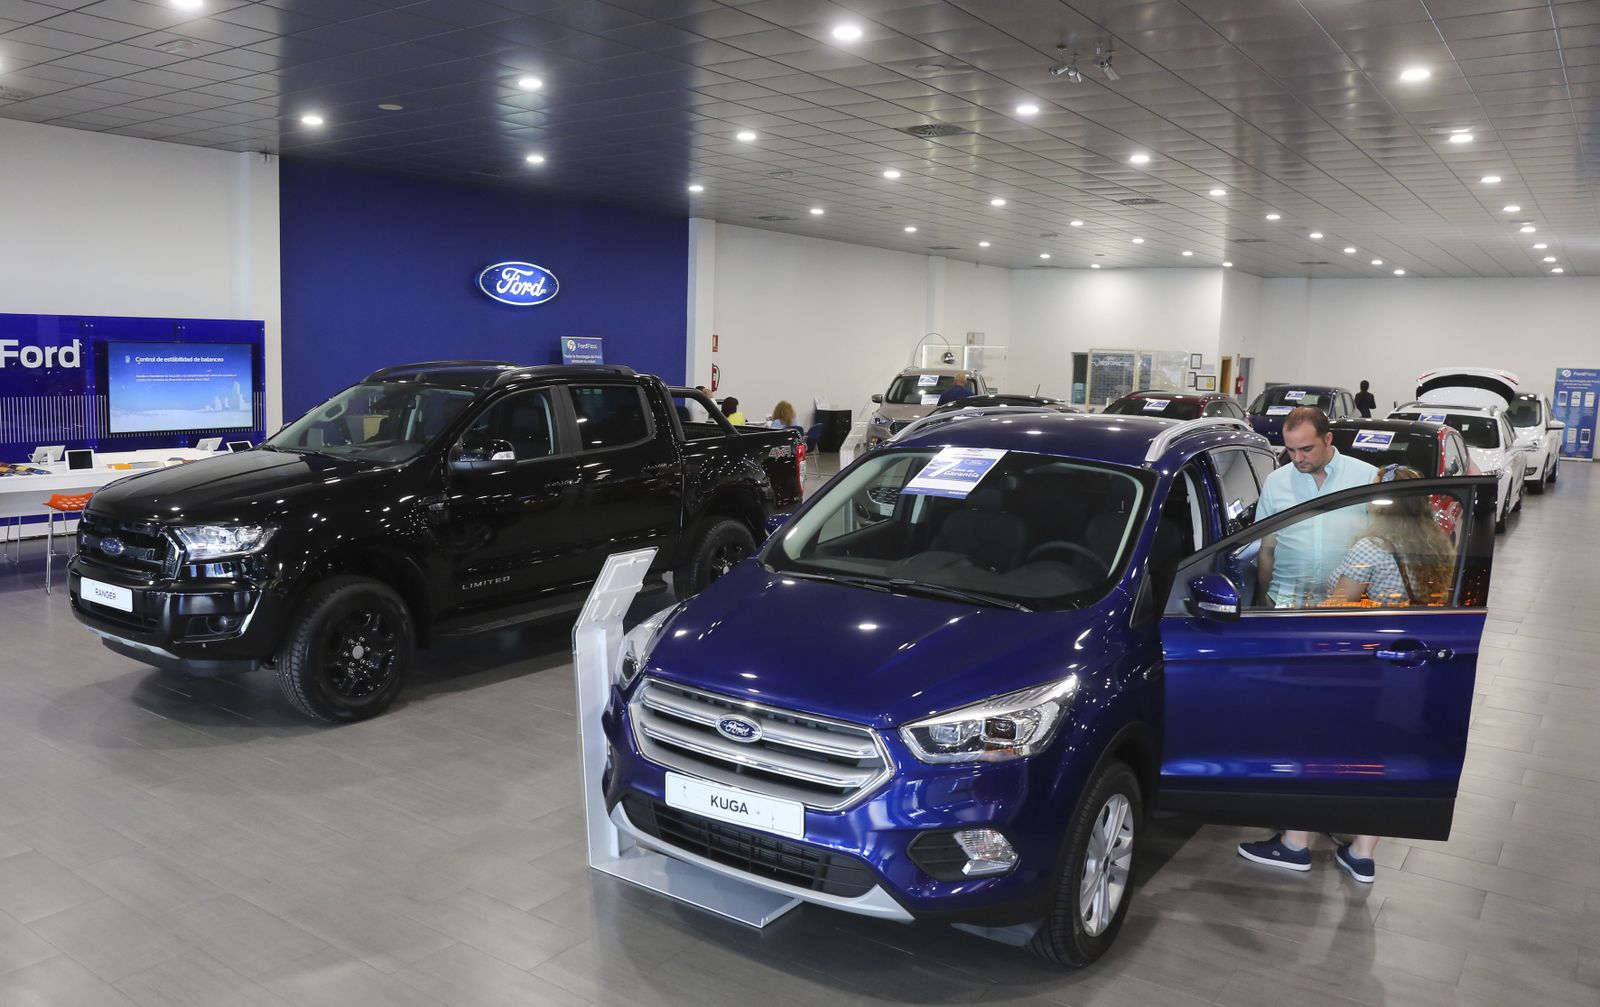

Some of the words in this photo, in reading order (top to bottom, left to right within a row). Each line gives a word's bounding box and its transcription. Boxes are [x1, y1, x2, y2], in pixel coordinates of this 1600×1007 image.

[496, 267, 548, 297] Ford
[0, 338, 81, 368] Ford
[928, 458, 964, 477] 7
[943, 470, 980, 478] Garantía
[462, 575, 511, 590] LIMITED
[95, 587, 117, 600] RANGER
[725, 720, 750, 736] Ford
[710, 794, 749, 815] KUGA
